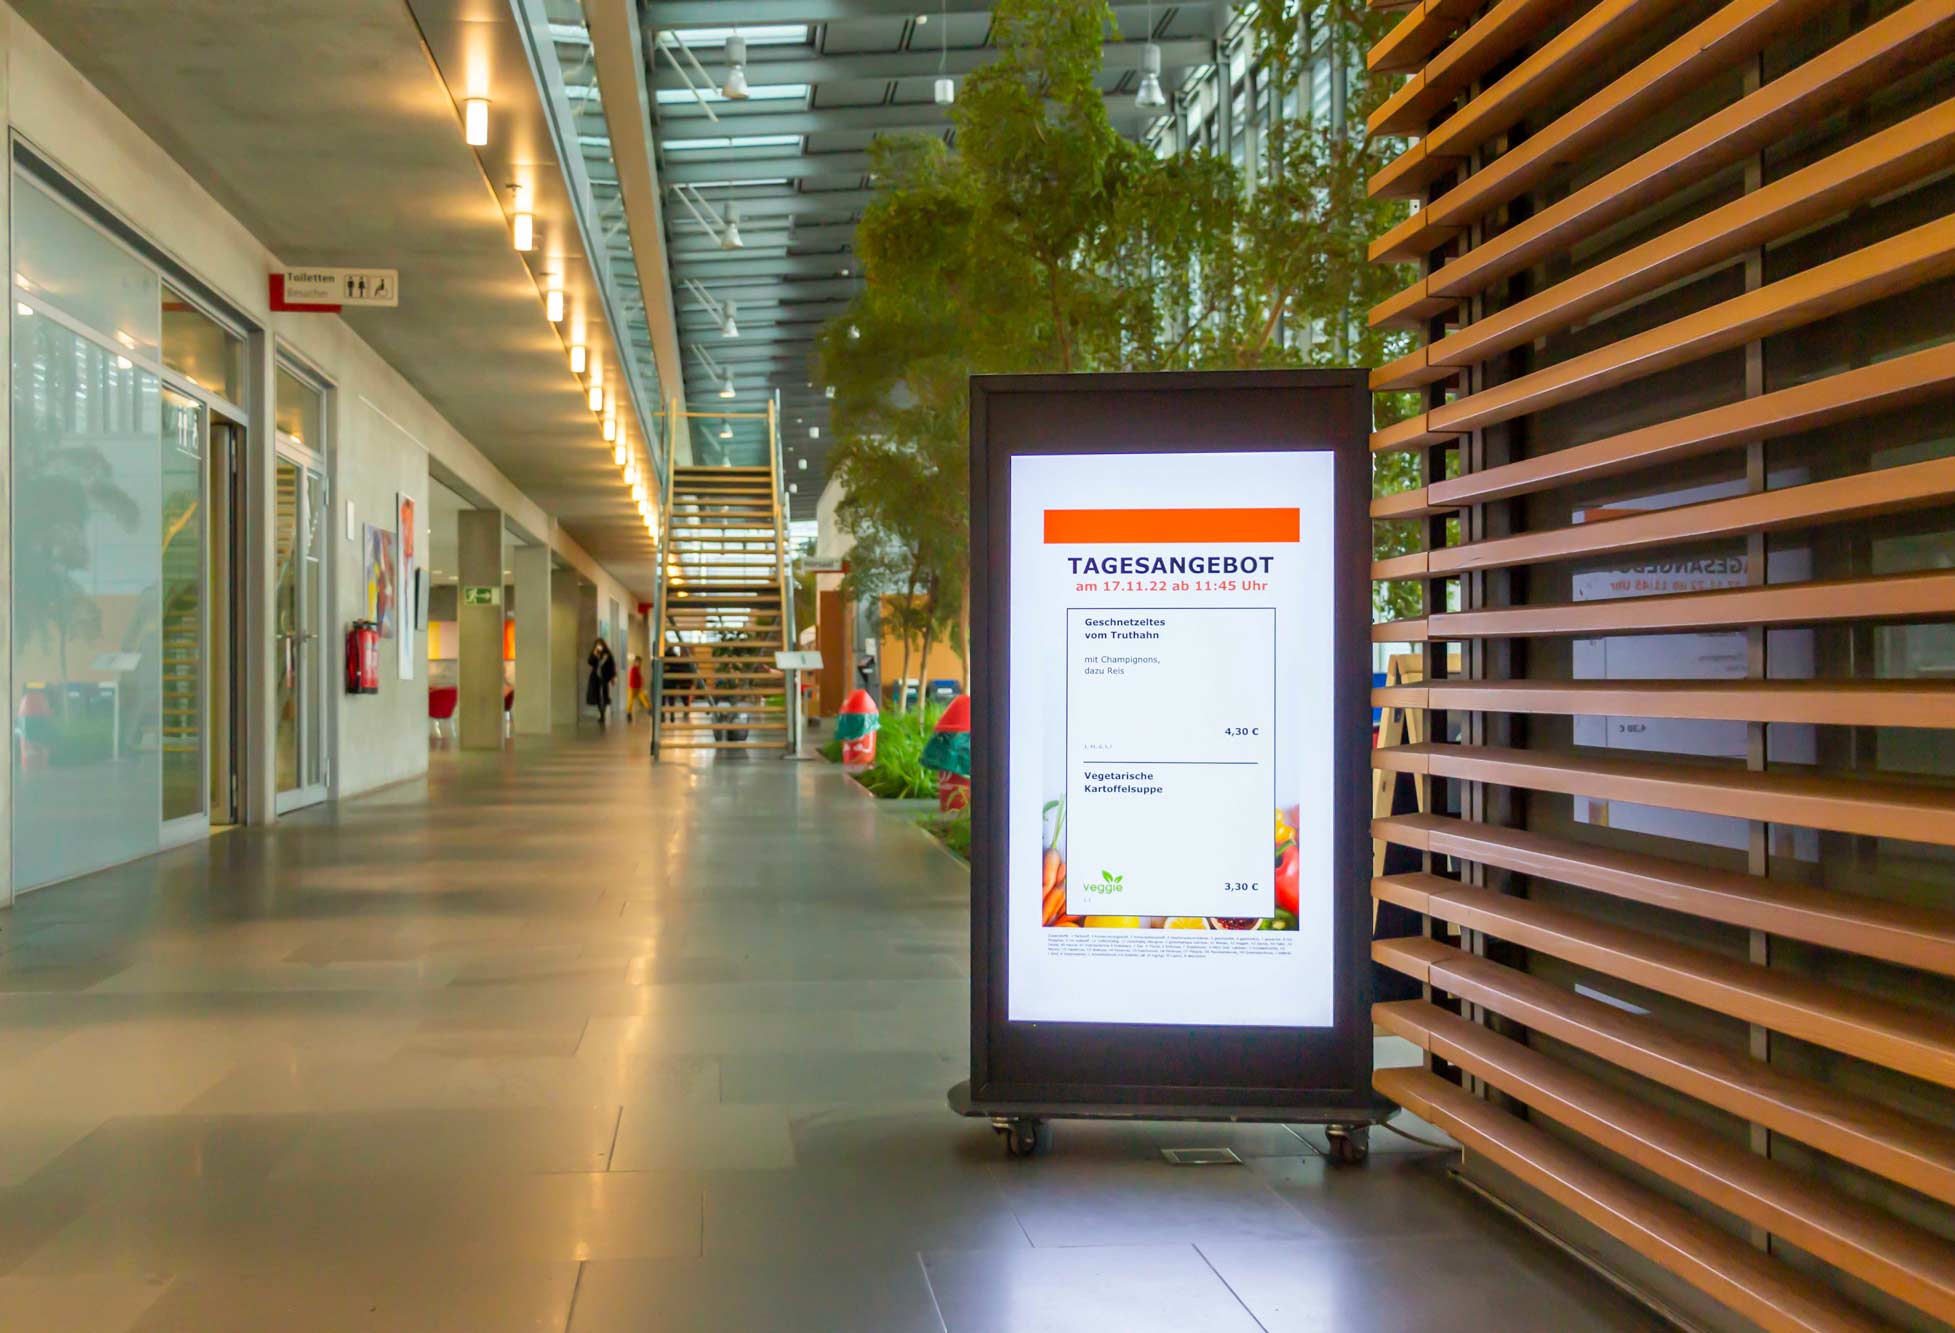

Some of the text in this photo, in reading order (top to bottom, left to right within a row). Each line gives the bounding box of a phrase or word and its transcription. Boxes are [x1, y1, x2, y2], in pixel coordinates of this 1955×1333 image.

[287, 271, 336, 283] Toiletten
[1067, 556, 1275, 575] TAGESANGEBOT
[1075, 580, 1268, 592] am 17.11.22 ab 11:45 Uhr
[1084, 617, 1166, 627] Geschnetzeltes
[1084, 631, 1160, 640] vom Truthahn
[1084, 655, 1161, 667] mit Champignons,
[1084, 666, 1125, 675] dazu Reis
[1224, 727, 1259, 737] 4,30 €
[1084, 771, 1154, 782] Vegetarische
[1084, 784, 1163, 795] Kartoffelsuppe
[1083, 883, 1123, 895] veggie
[1224, 882, 1259, 892] 3,30 €
